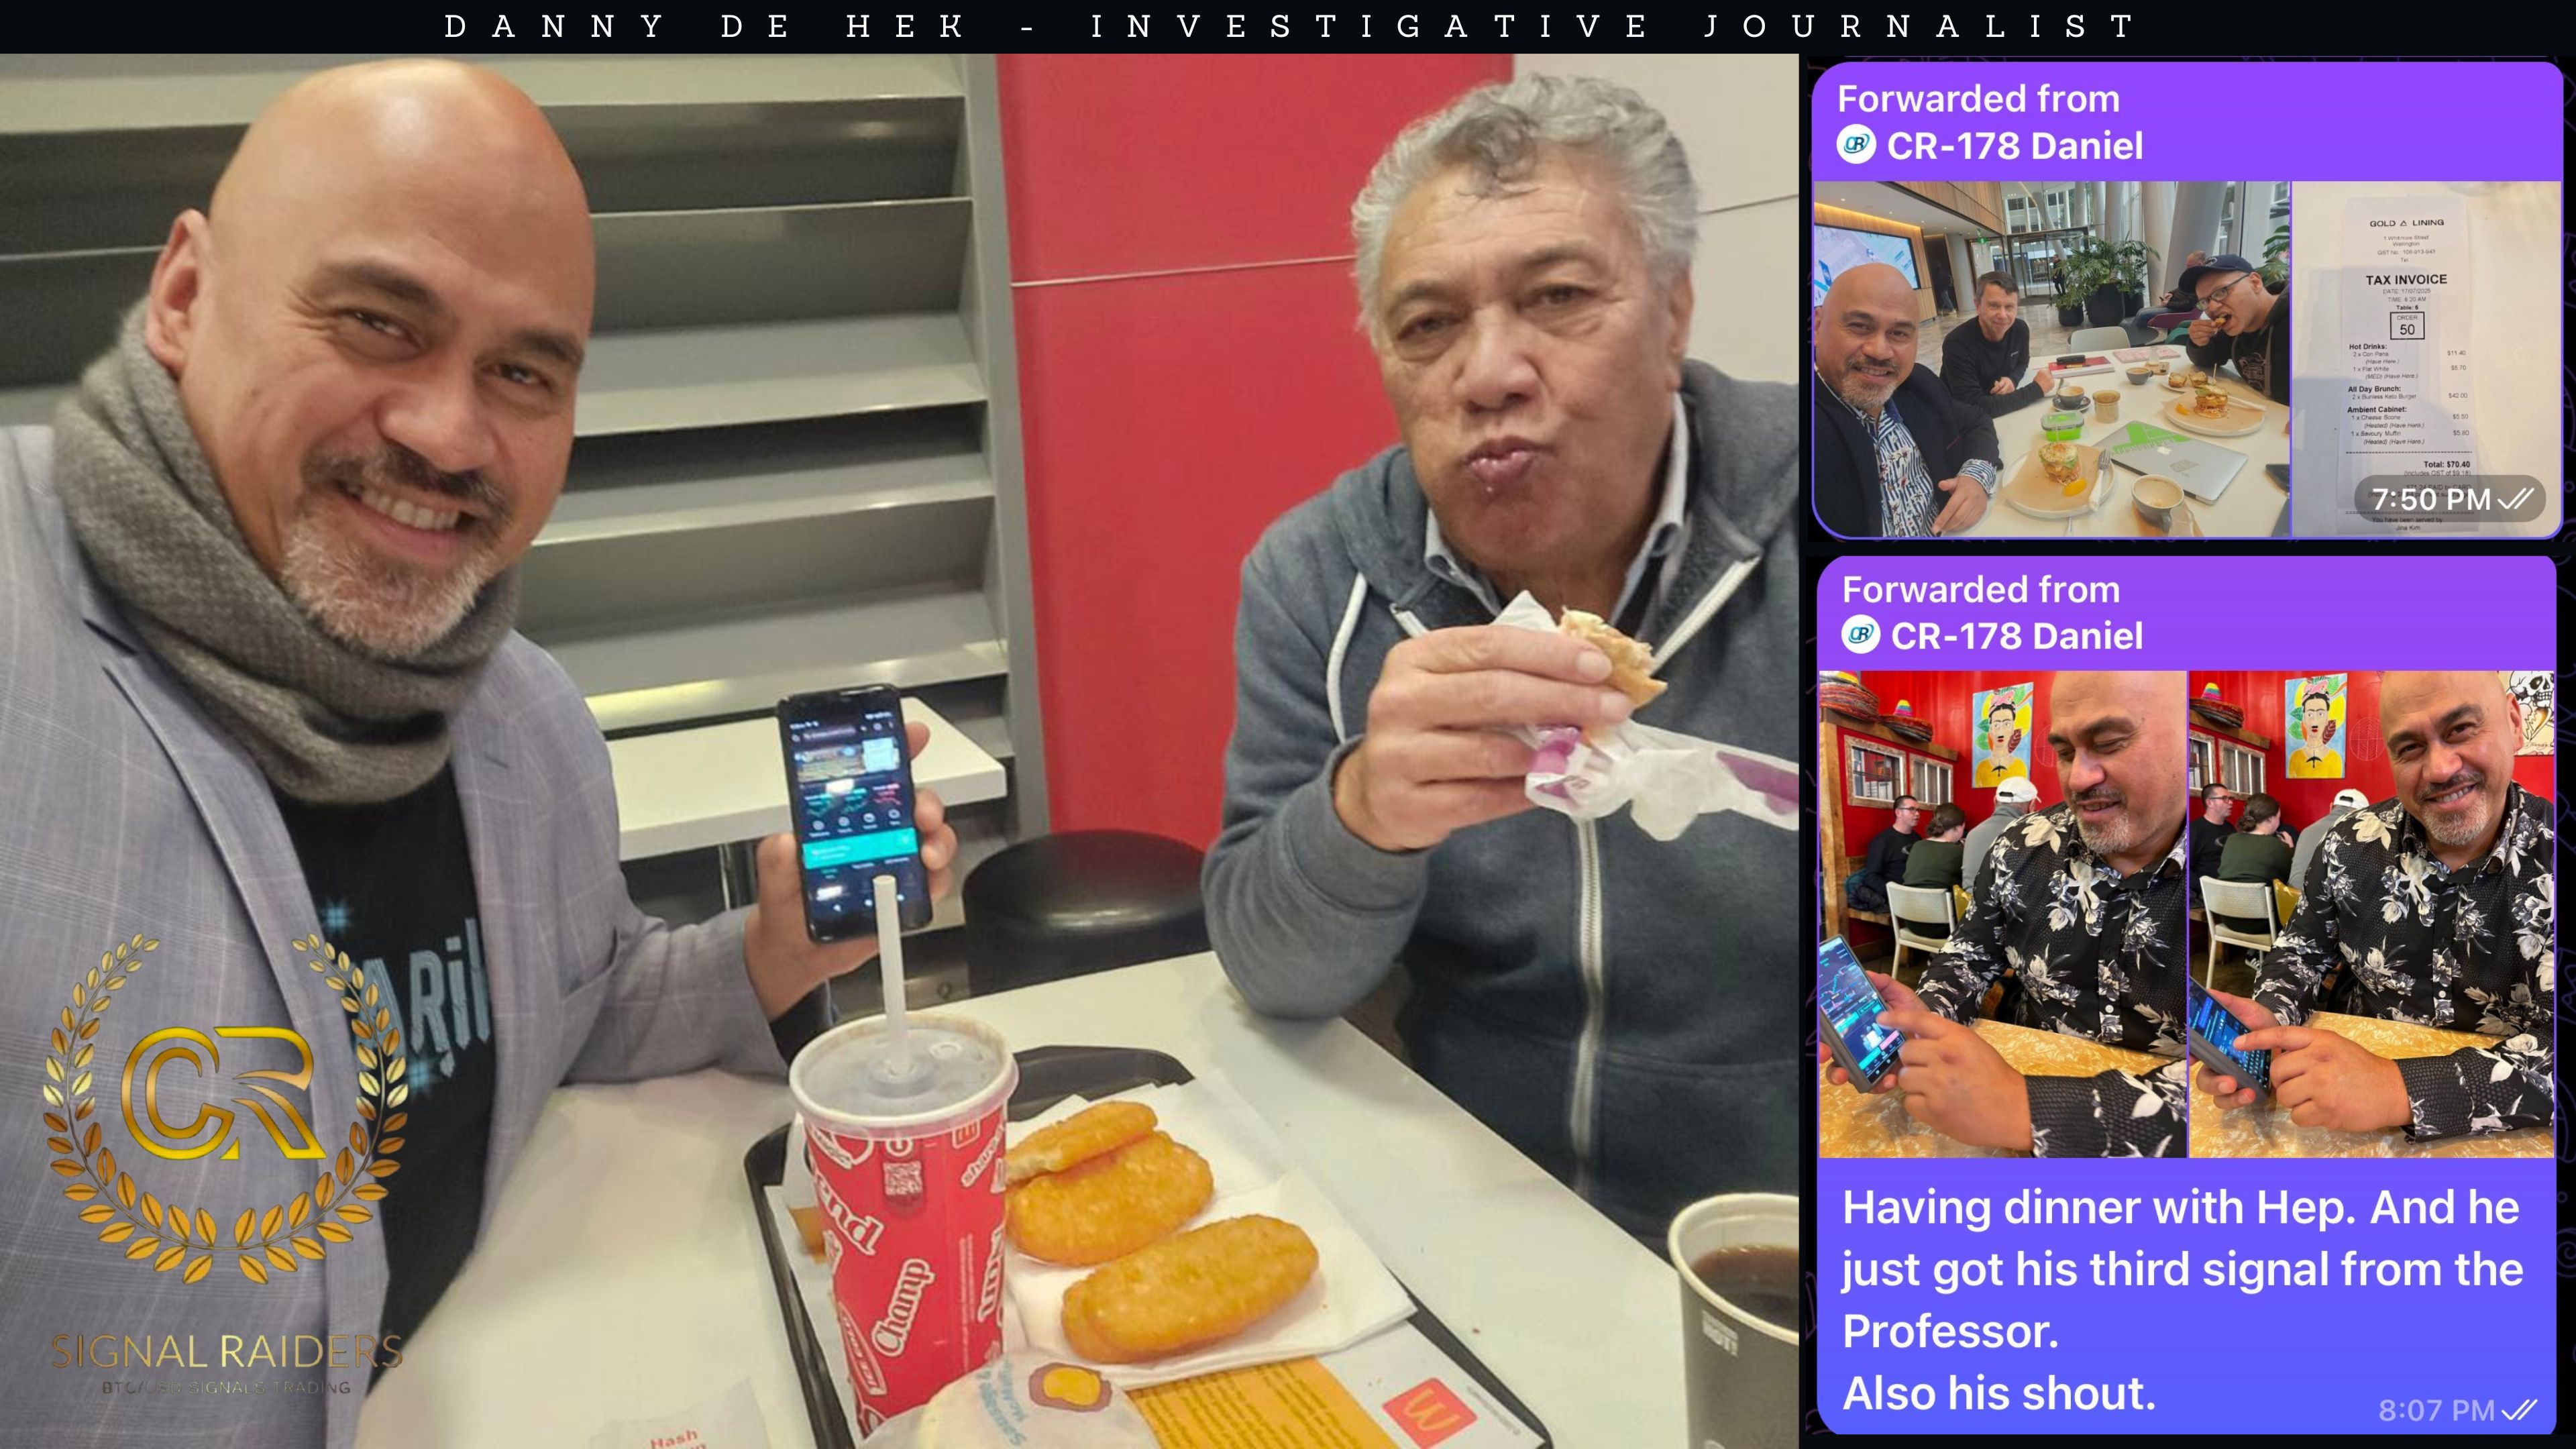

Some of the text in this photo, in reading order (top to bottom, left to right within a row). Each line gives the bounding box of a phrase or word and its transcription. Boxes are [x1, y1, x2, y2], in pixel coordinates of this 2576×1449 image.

[2366, 274, 2448, 286] TAX INVOICE
[2400, 324, 2415, 335] 50
[2447, 460, 2471, 468] $70.40
[871, 1258, 936, 1357] Champ
